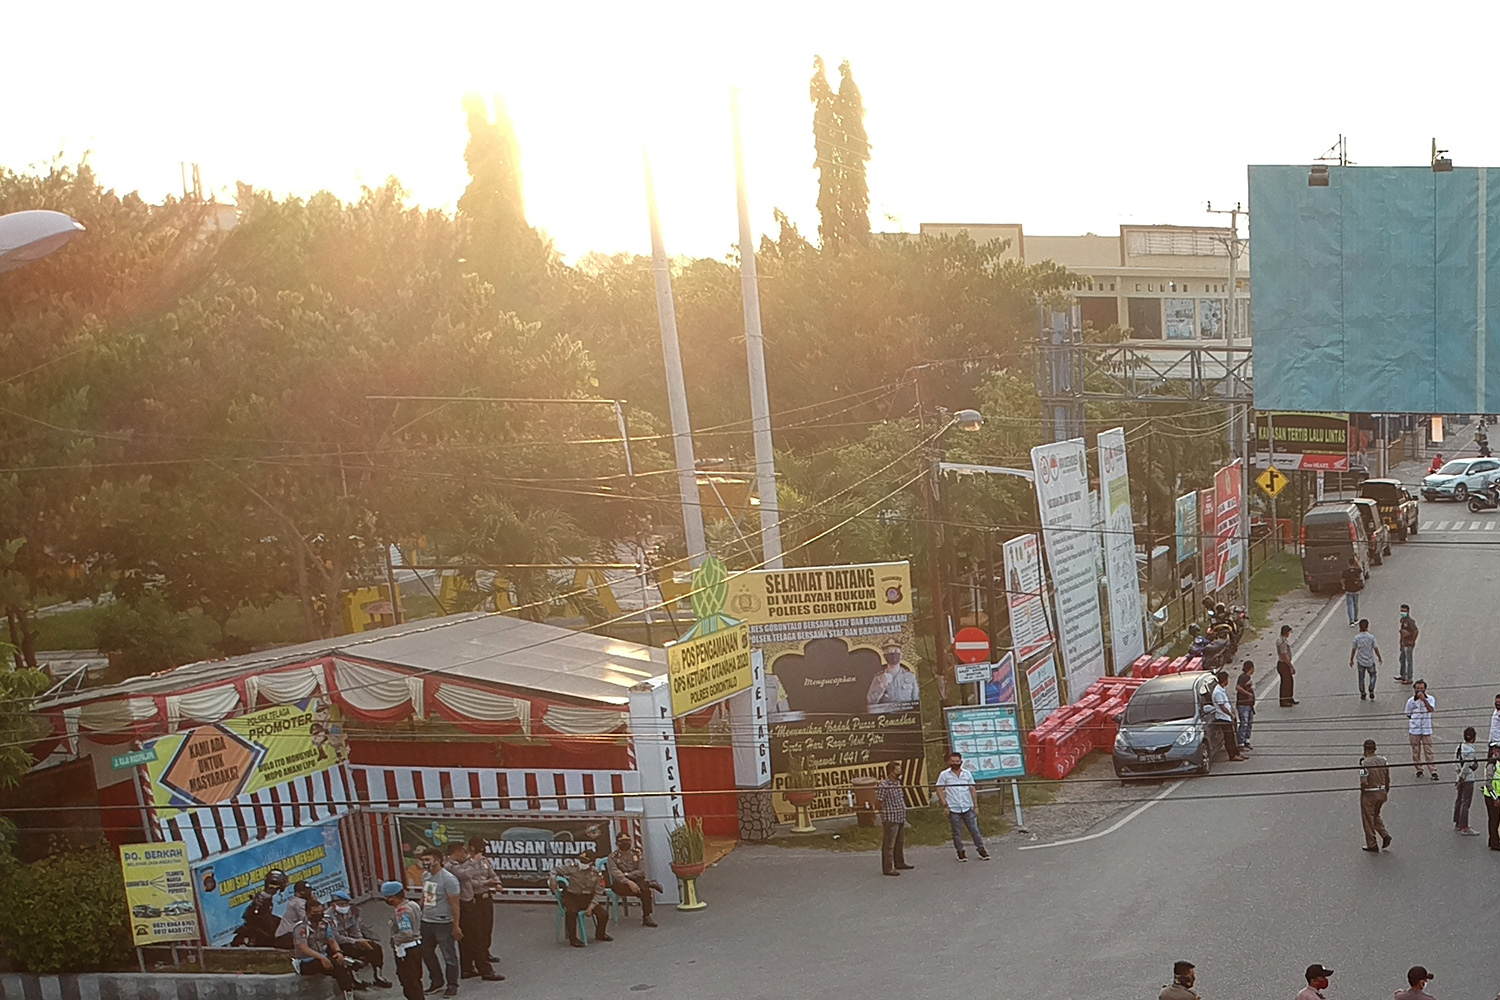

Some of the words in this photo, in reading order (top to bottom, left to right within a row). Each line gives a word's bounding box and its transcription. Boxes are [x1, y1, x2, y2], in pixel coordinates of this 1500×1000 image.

[1258, 427, 1286, 440] KAASAN
[1288, 428, 1308, 442] TERTIB
[1309, 428, 1324, 442] LALU
[1325, 429, 1346, 443] LINTAS
[766, 572, 823, 594] SELAMAT
[826, 568, 876, 590] DATANG
[766, 595, 780, 606] DI
[783, 591, 832, 604] WILAYAH
[836, 589, 876, 601] HUKUM
[768, 604, 812, 618] POLRES
[813, 600, 877, 615] GORONTALO
[803, 618, 834, 630] BERSAMA
[682, 647, 696, 670] POS
[696, 632, 740, 666] PENGAMANAN
[674, 676, 686, 694] OPS
[686, 666, 711, 690] KETUPAT
[712, 657, 737, 680] OTANAHA
[737, 652, 749, 672] 2020
[804, 675, 856, 688] Mengucapkan
[690, 688, 709, 704] POLRES
[709, 676, 738, 698] GORONTALO
[268, 708, 290, 719] TELAGA
[754, 666, 768, 776] TELAGA
[852, 717, 876, 730] Puasa
[878, 714, 916, 728] Ramadhan
[249, 713, 312, 740] PROMOTER
[188, 741, 209, 759] KAMI
[209, 737, 227, 753] ADA
[805, 738, 824, 751] Hari
[826, 736, 846, 750] Raya
[866, 732, 884, 746] Fitri
[198, 754, 225, 773] UNTUK
[839, 751, 858, 764] 1441
[861, 750, 870, 761] H
[189, 766, 240, 792] MASYARAKAT
[144, 848, 182, 860] BERKAH
